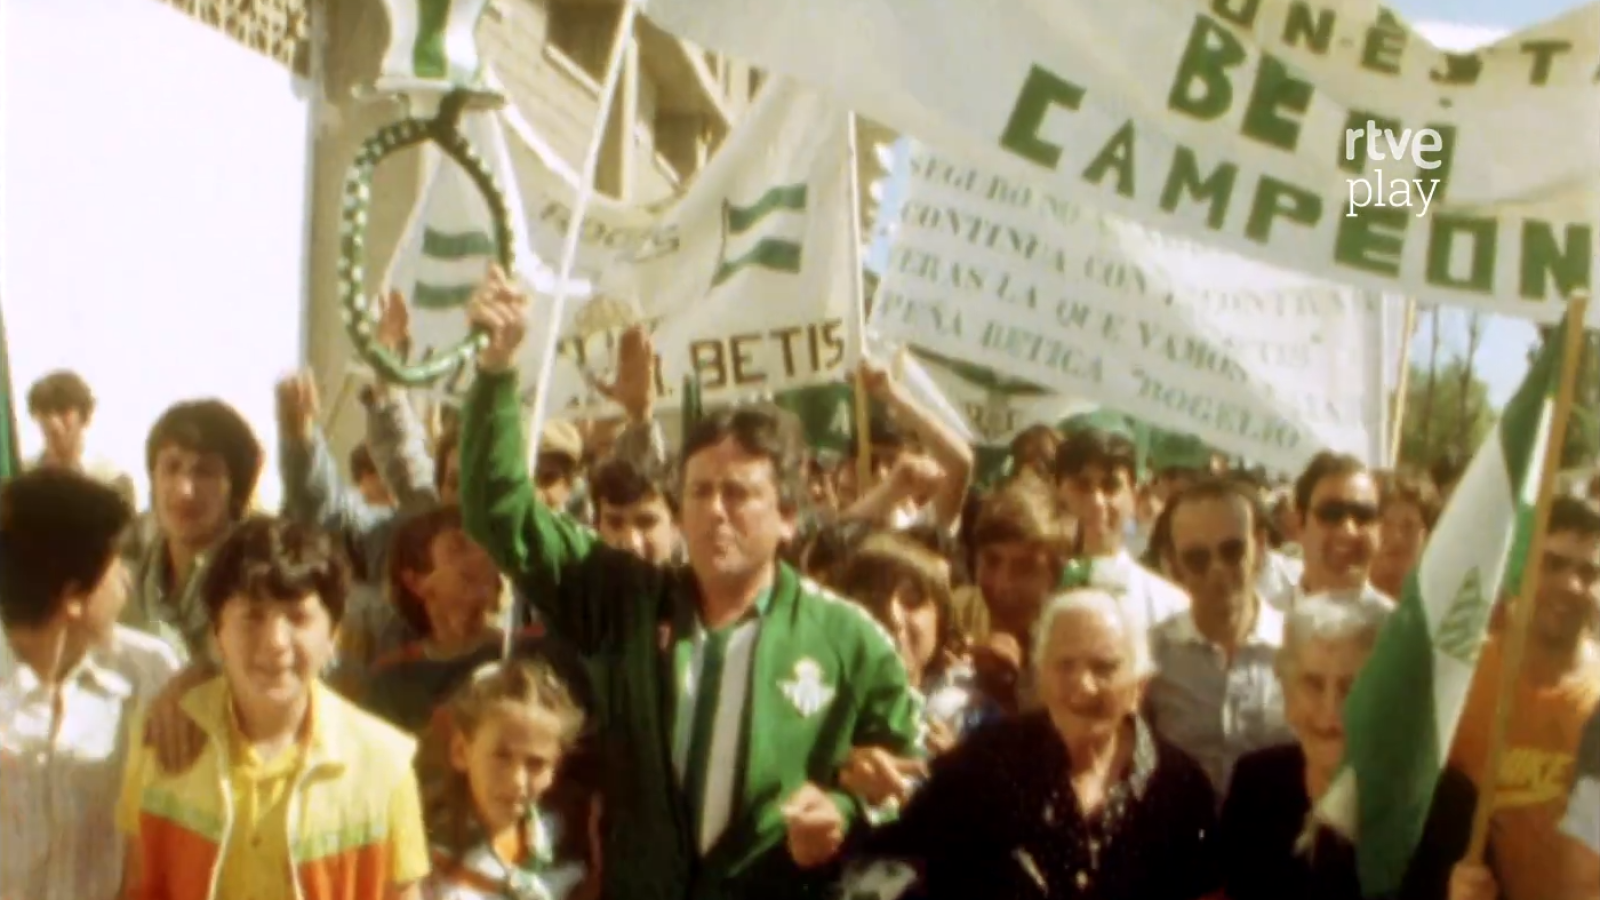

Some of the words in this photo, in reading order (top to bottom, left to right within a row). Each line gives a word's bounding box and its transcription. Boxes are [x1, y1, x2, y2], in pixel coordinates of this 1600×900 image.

[998, 63, 1593, 302] CAMPEON
[900, 201, 1067, 274] CONTINUA
[996, 271, 1038, 310] LA
[690, 320, 846, 391] BETIS
